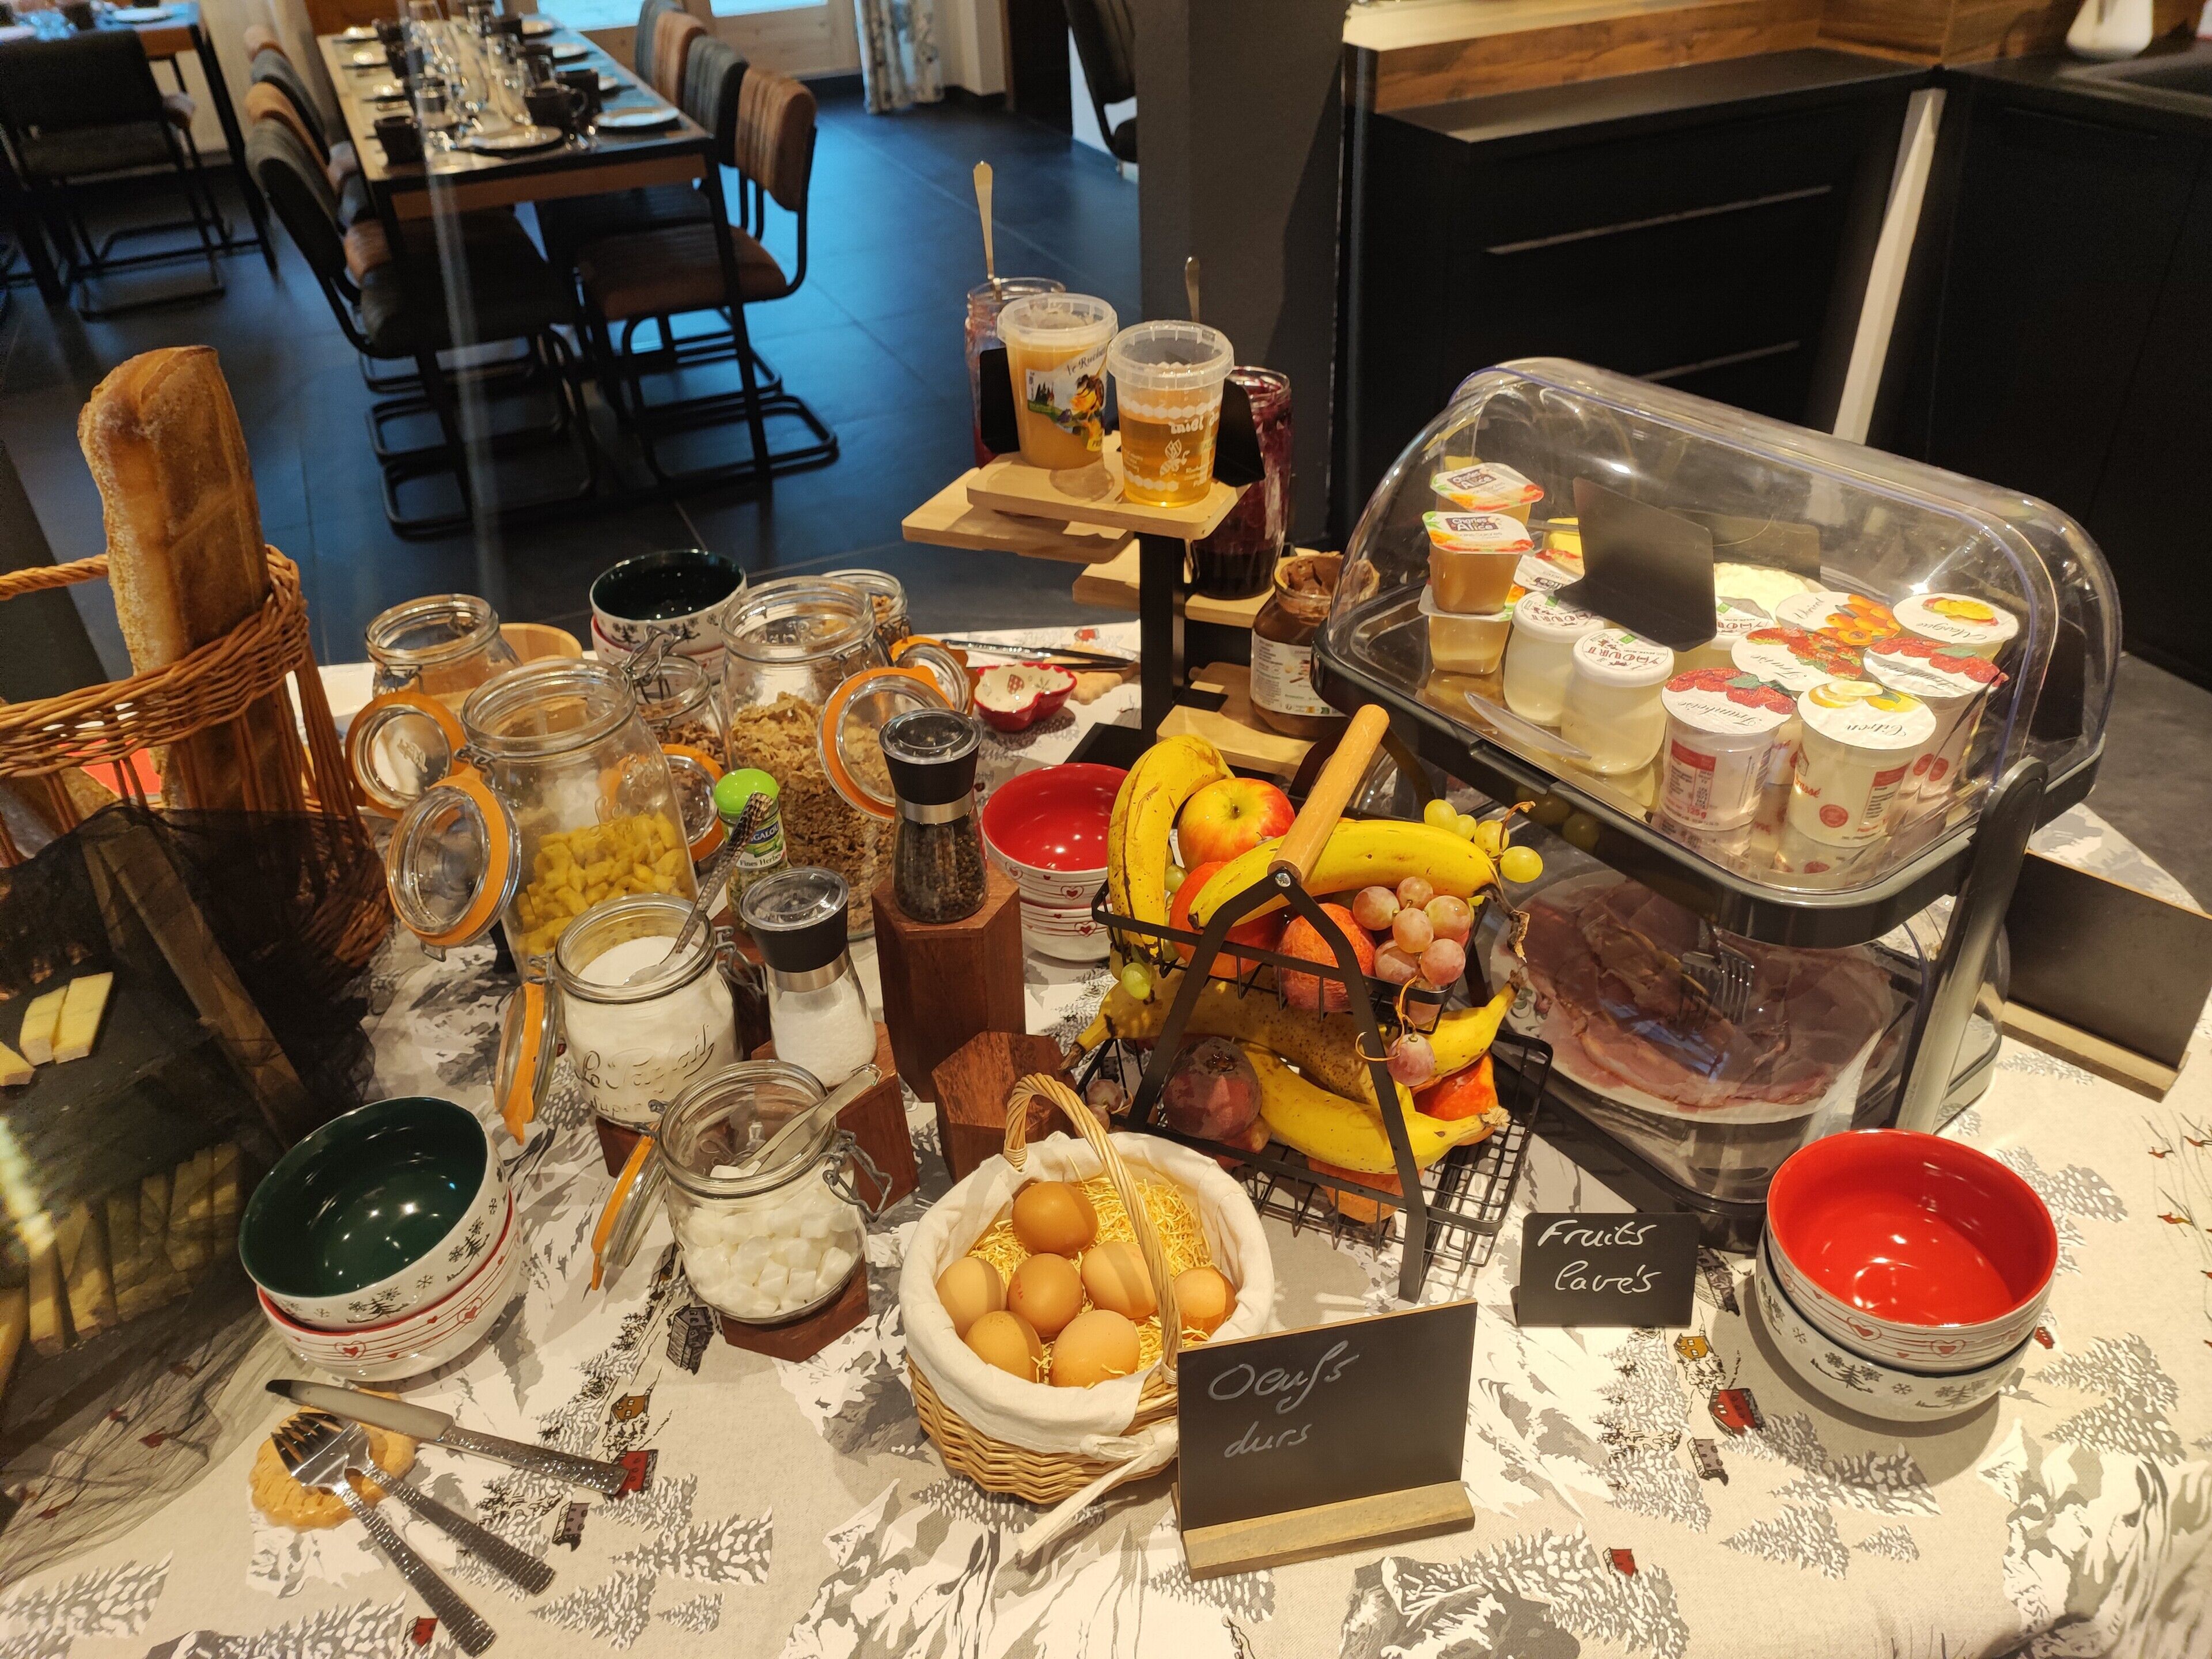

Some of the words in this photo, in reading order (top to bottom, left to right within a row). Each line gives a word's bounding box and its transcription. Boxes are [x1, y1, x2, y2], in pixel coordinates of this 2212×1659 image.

[1456, 523, 1494, 531] Alice
[1586, 646, 1660, 665] YAOURT
[1676, 702, 1763, 727] Framboise
[1846, 724, 1907, 737] Citron
[1537, 1219, 1658, 1247] Fruits
[1208, 1340, 1360, 1415] Oeufs
[1224, 1421, 1313, 1459] durs
